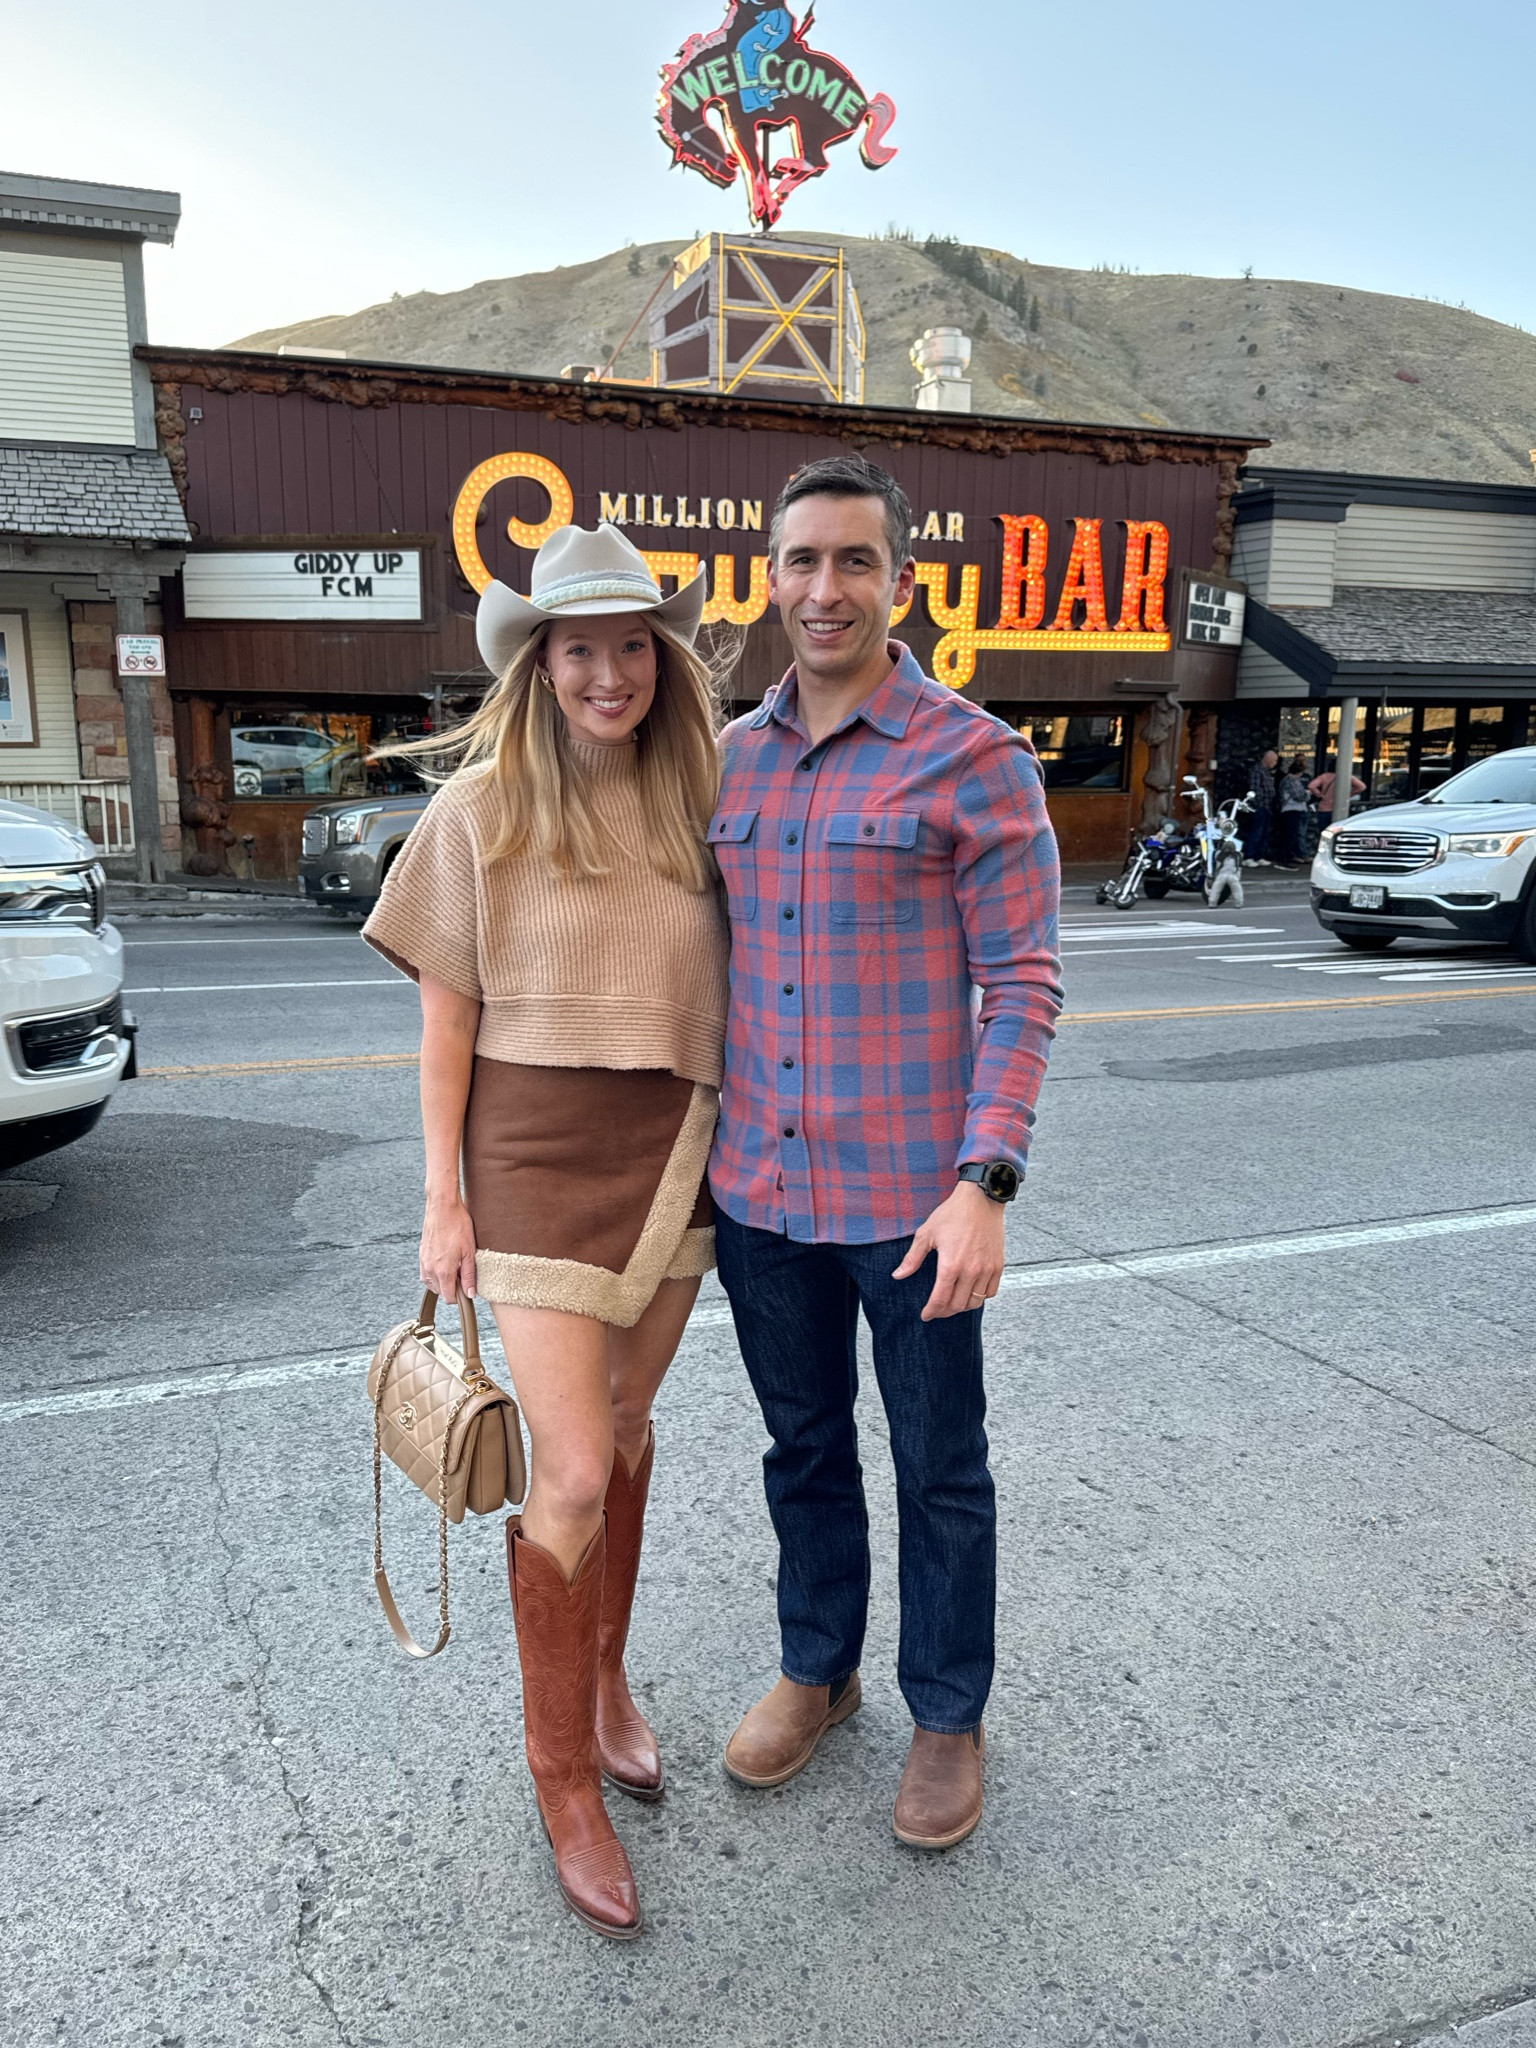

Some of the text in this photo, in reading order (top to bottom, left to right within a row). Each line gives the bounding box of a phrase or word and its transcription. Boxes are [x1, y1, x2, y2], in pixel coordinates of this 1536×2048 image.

[669, 52, 865, 128] WELCOME
[598, 491, 763, 531] MILLION
[294, 553, 404, 575] GIDDY UP
[990, 513, 1170, 633] BAR
[321, 576, 373, 597] FCM
[1360, 836, 1398, 850] GMC
